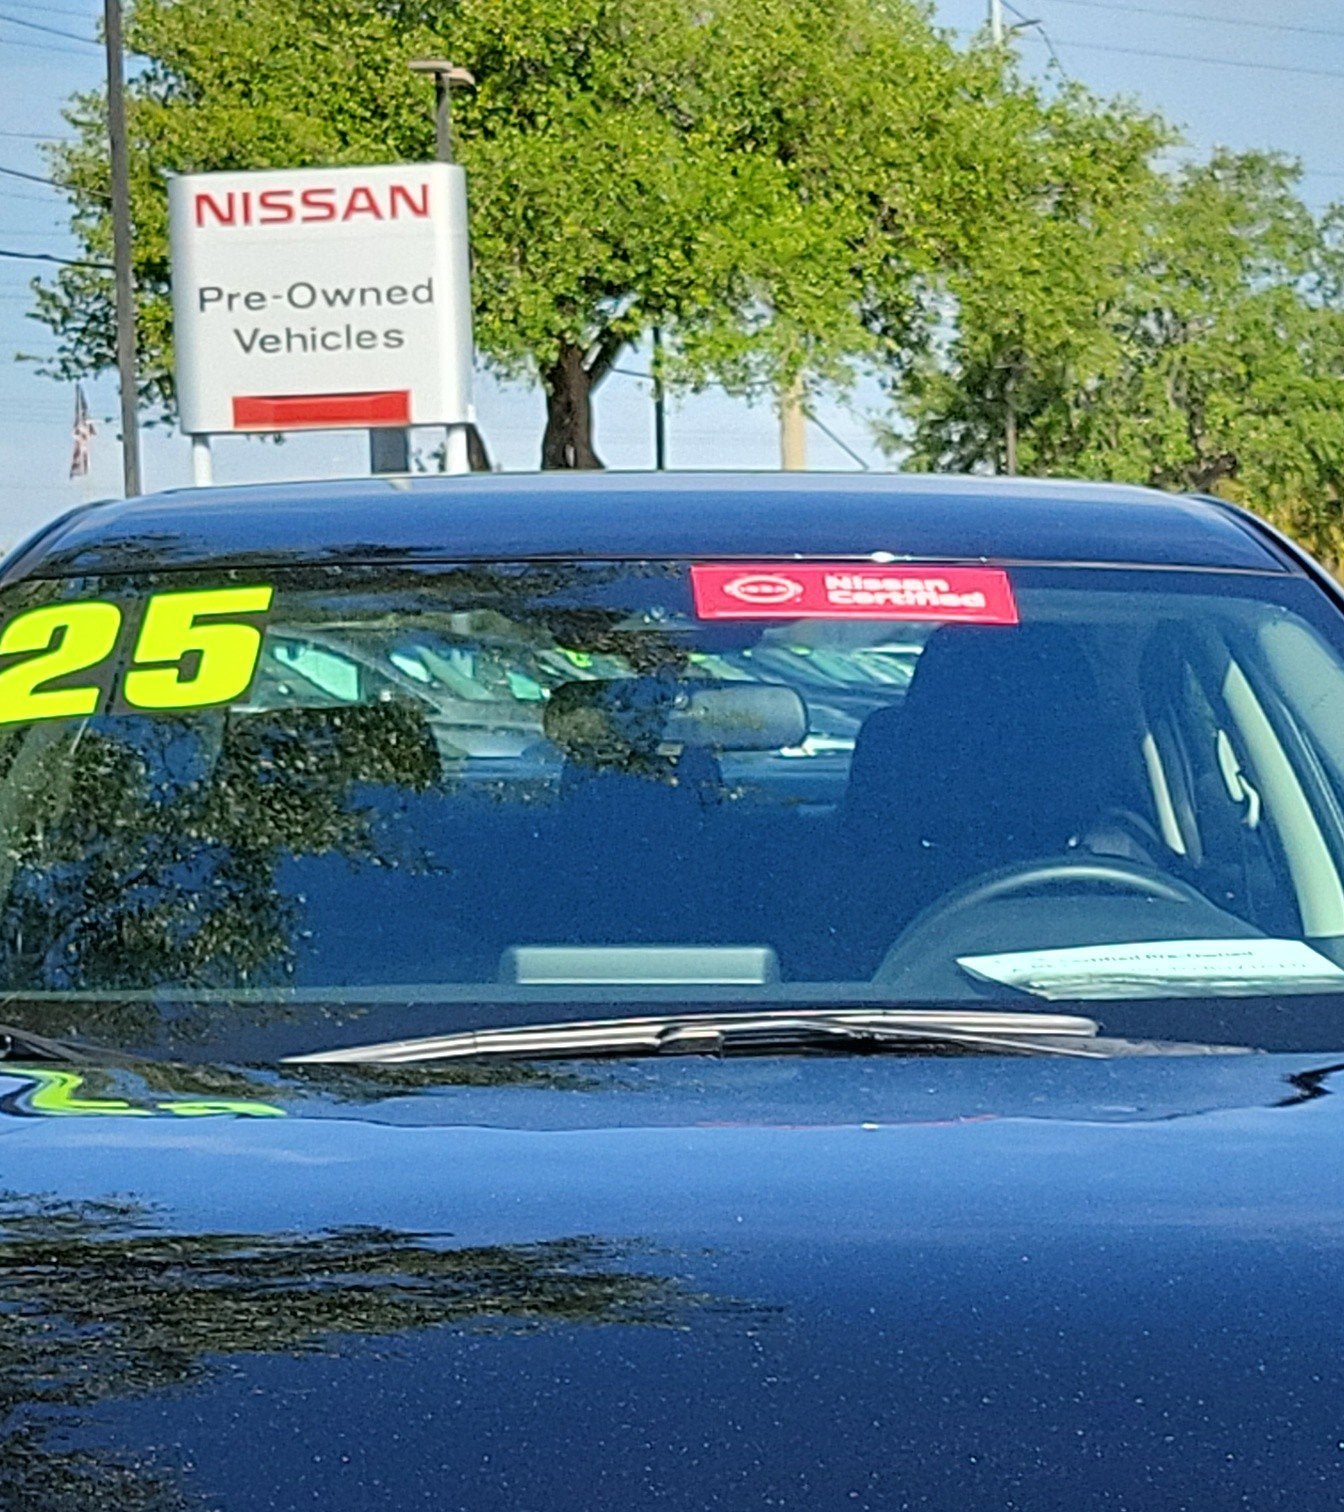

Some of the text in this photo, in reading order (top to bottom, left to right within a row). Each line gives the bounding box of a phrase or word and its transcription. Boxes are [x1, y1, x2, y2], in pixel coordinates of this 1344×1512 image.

[195, 184, 431, 228] NISSAN
[199, 277, 434, 312] Pre-Owned
[234, 324, 404, 353] Vehicles
[824, 573, 950, 592] Nissan
[825, 588, 986, 608] Certified
